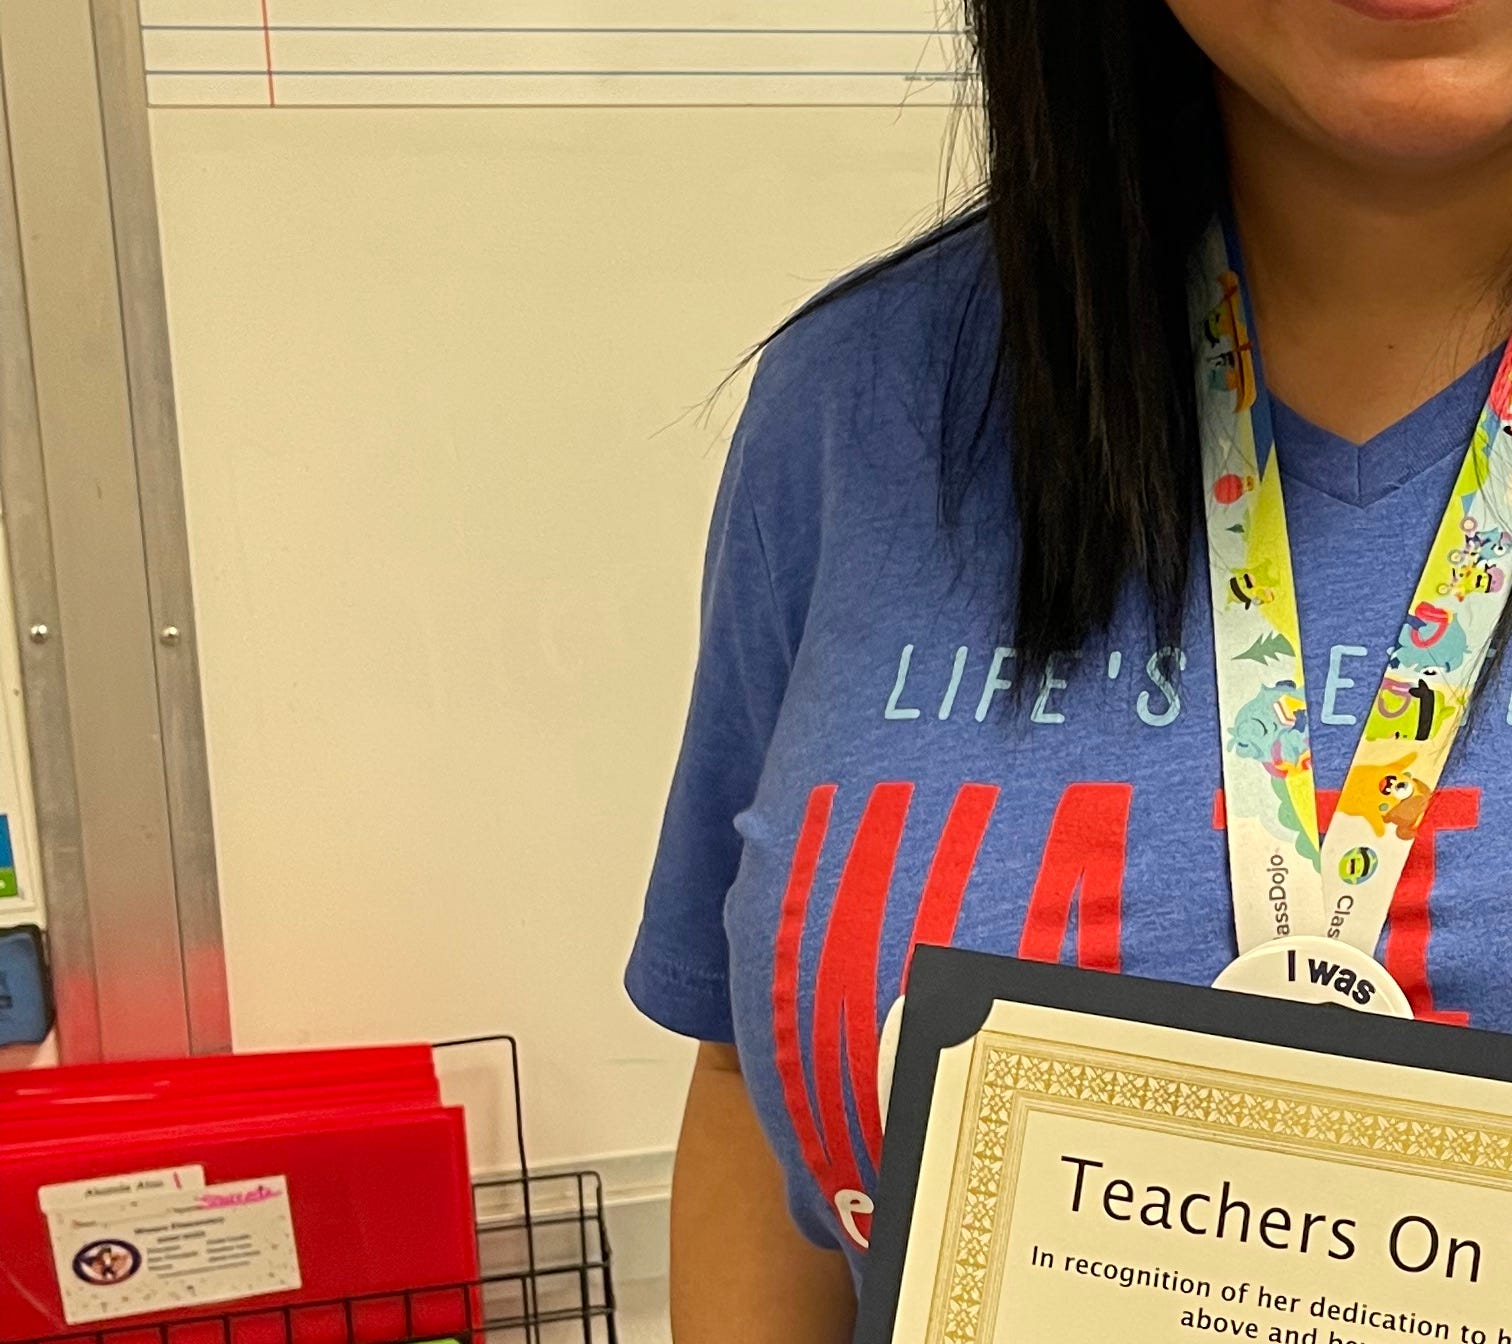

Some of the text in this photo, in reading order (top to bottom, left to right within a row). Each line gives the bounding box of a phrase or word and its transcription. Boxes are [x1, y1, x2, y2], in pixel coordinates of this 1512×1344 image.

[1287, 949, 1376, 1005] I was
[1060, 1154, 1357, 1261] Teachers
[1388, 1214, 1483, 1284] On
[1030, 1245, 1055, 1269] In
[1063, 1254, 1212, 1298] recognition
[1220, 1282, 1251, 1304] of
[1257, 1285, 1302, 1314] her
[1309, 1296, 1450, 1341] dedication
[1179, 1308, 1260, 1341] above
